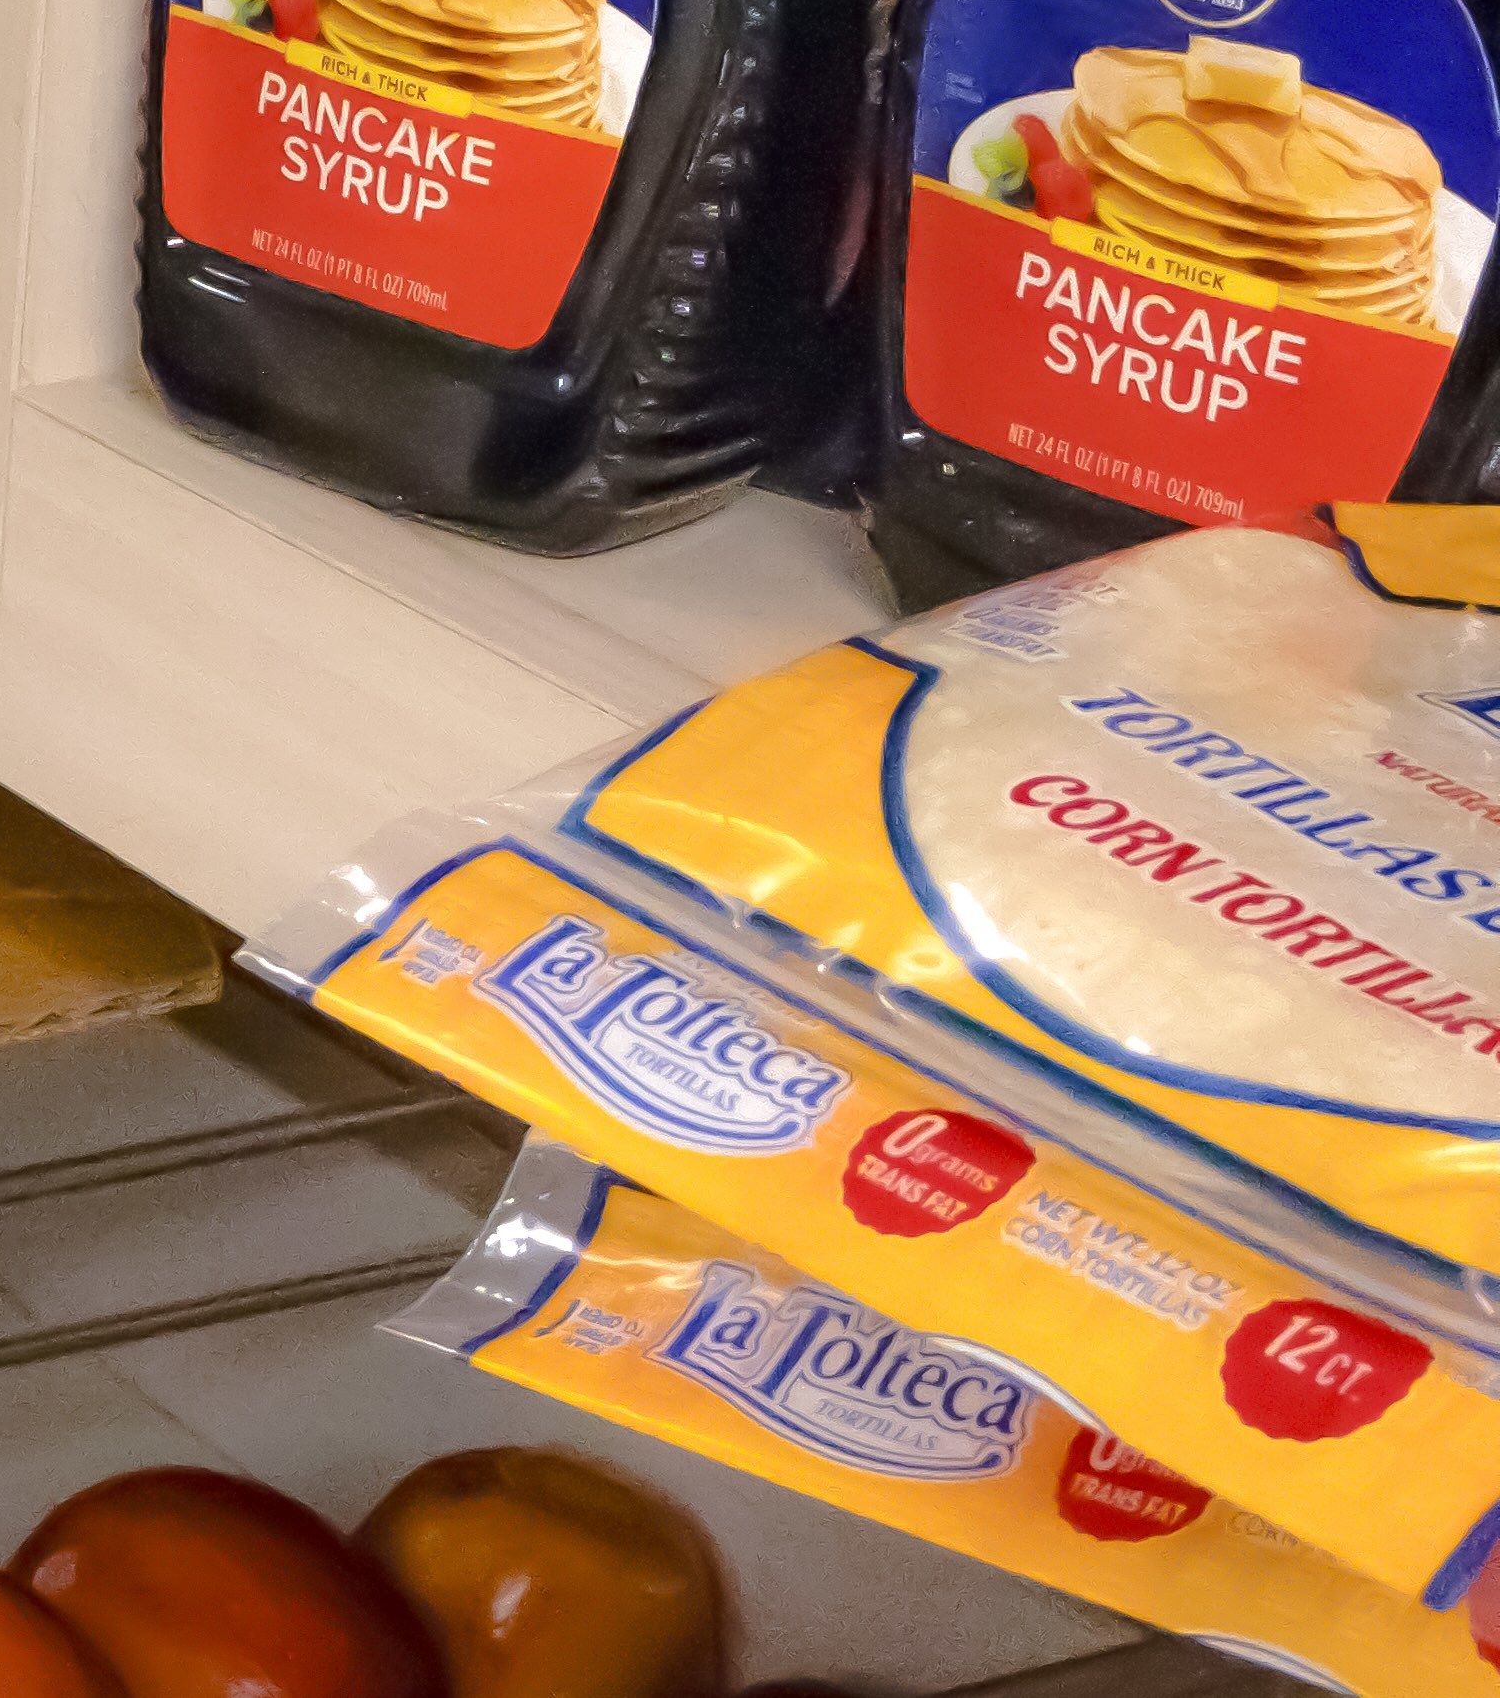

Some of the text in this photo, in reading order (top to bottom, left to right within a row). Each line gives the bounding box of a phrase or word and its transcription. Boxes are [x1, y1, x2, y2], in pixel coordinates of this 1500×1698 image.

[319, 54, 361, 85] RICH
[377, 73, 429, 103] THICK
[255, 68, 497, 187] PANCAKE
[279, 135, 450, 223] SYRUP
[252, 227, 274, 253] NET
[274, 236, 289, 261] 24
[289, 242, 304, 265] FL
[306, 247, 324, 271] OZ
[336, 257, 353, 280] PT
[364, 266, 379, 291] FL
[382, 272, 404, 300] OZ)
[1093, 236, 1141, 267] RICH
[1163, 257, 1228, 292] THICK
[1014, 251, 1308, 386] PANCAKE
[1042, 324, 1250, 423] SYRUP
[1008, 422, 1035, 450] NET
[1035, 432, 1055, 457] 24
[1054, 439, 1070, 464] FL
[1074, 446, 1095, 473] OZ
[1110, 459, 1130, 483] PT
[1144, 470, 1161, 496] FL
[1165, 477, 1192, 506] OZ)
[1008, 774, 1222, 882] CORN
[1070, 686, 1493, 902] TORTILLAS
[488, 920, 590, 1002] La
[573, 958, 846, 1110] Tolteca
[624, 1041, 741, 1112] TORTILLAS
[857, 1154, 968, 1221] TRANS FAT
[1027, 1189, 1096, 1226] NET
[1004, 1216, 1073, 1260] CORN
[664, 1282, 766, 1362] La
[756, 1301, 1026, 1435] Tolteca
[1263, 1314, 1340, 1374] 12
[816, 1397, 940, 1452] TORTILLAS
[1068, 1471, 1145, 1513] TRANS
